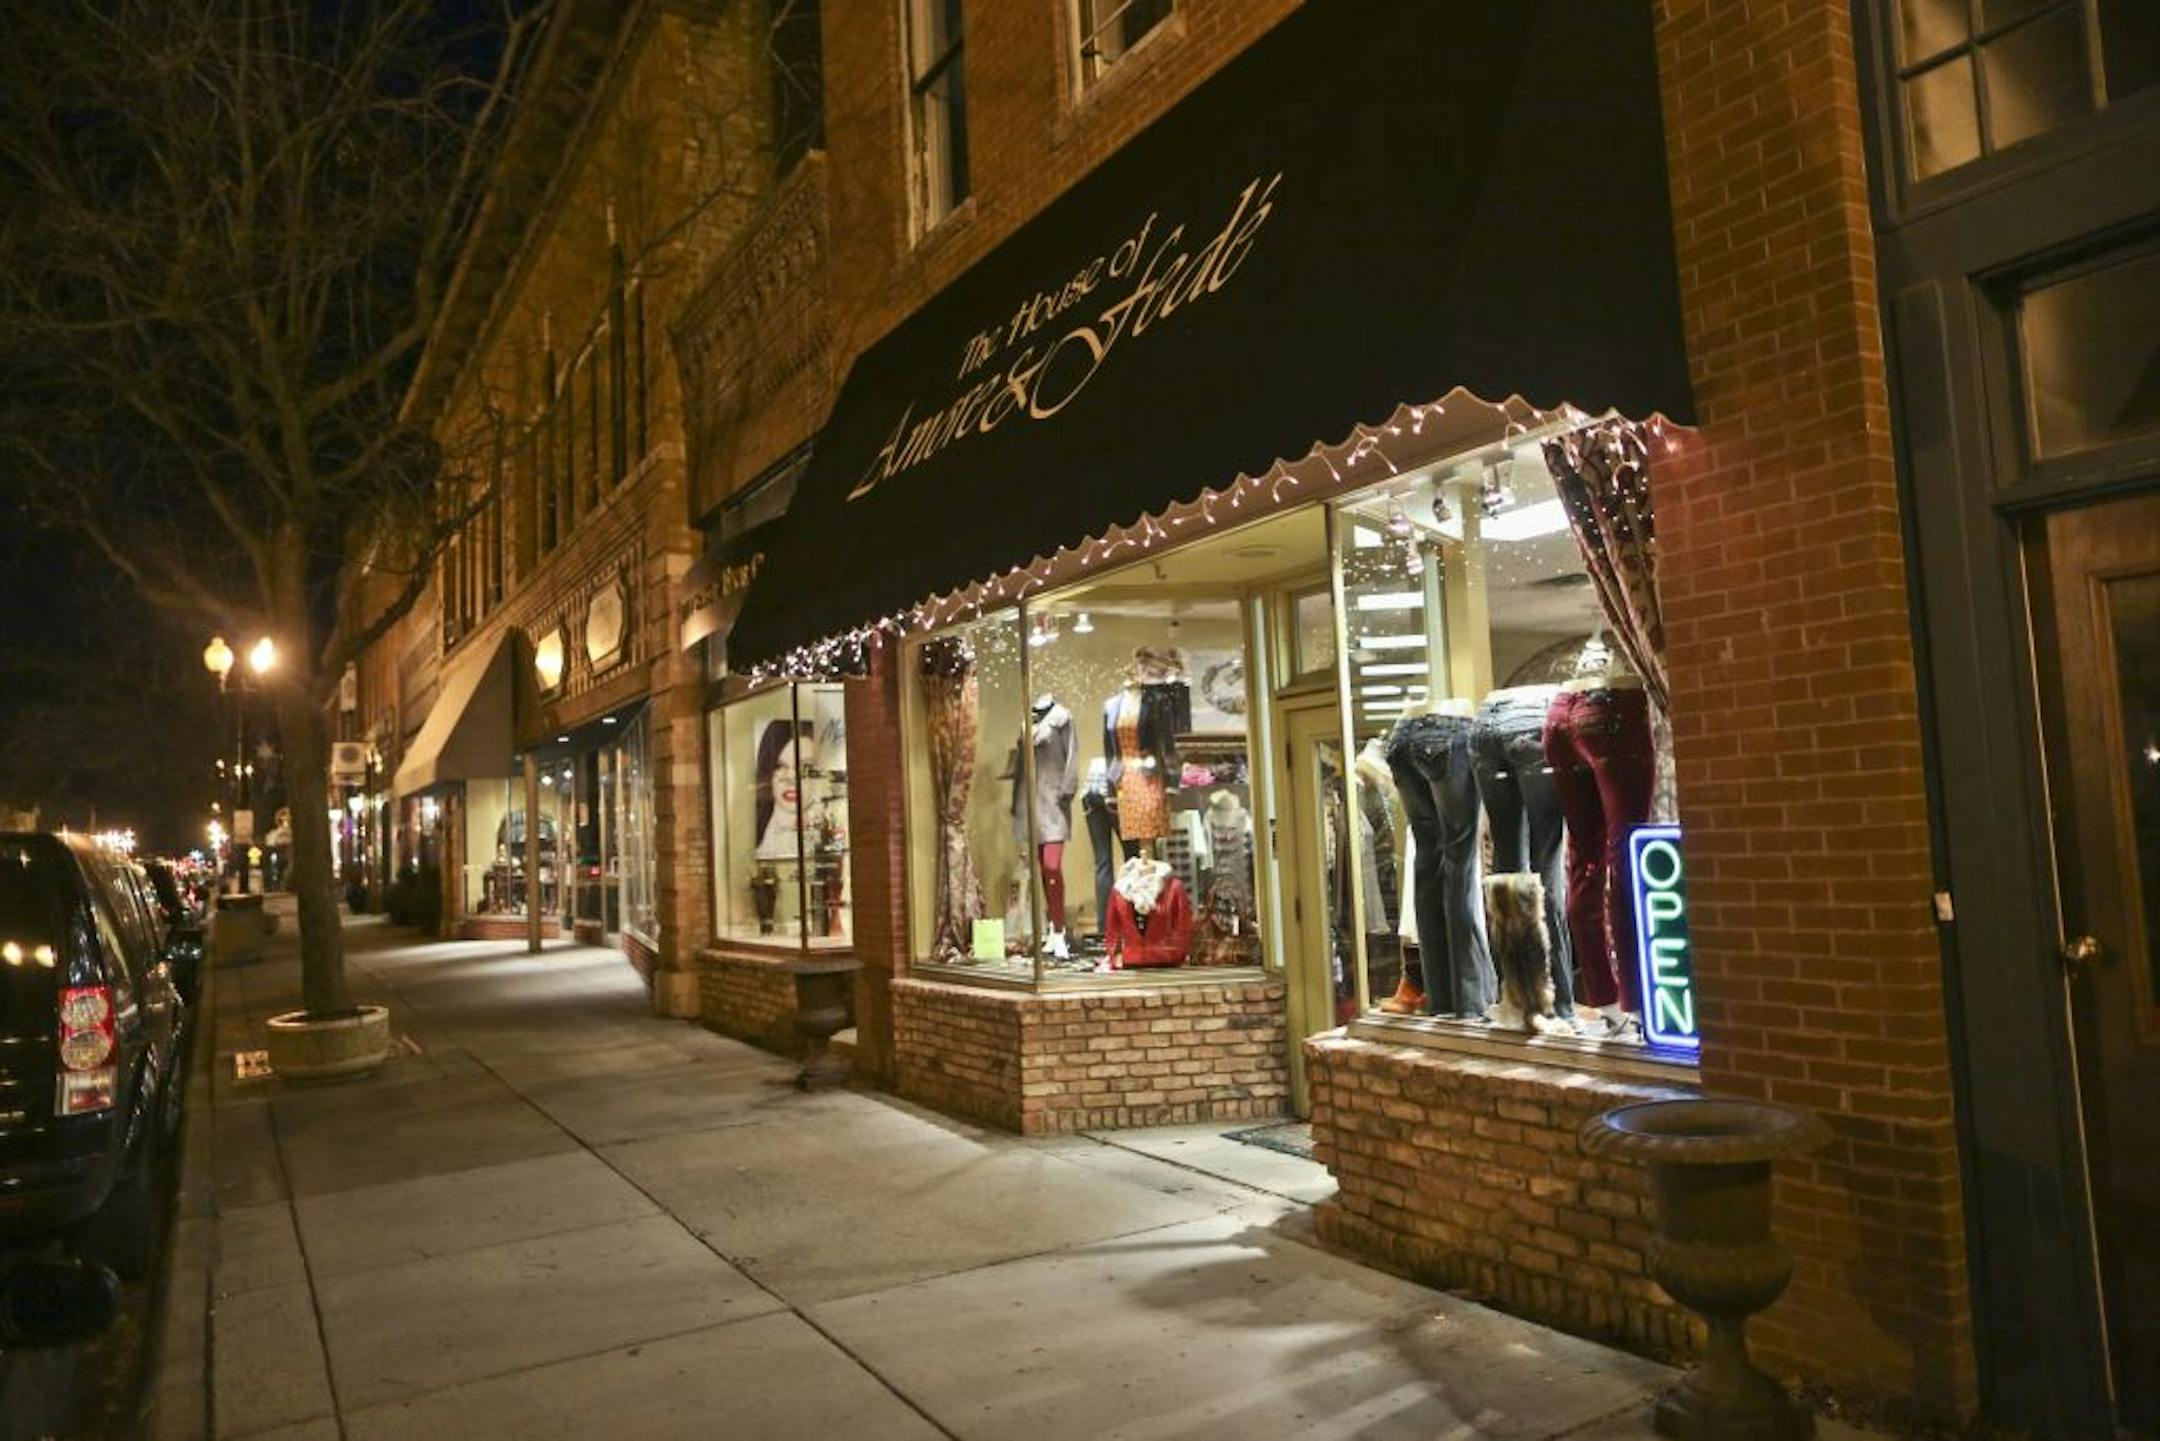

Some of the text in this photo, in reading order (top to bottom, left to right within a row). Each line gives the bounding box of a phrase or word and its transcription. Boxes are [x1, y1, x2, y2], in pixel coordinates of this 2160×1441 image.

[957, 211, 1158, 379] The House of
[847, 373, 1001, 500] Amore
[980, 345, 1052, 433] &
[1639, 839, 1694, 1034] OPEN
